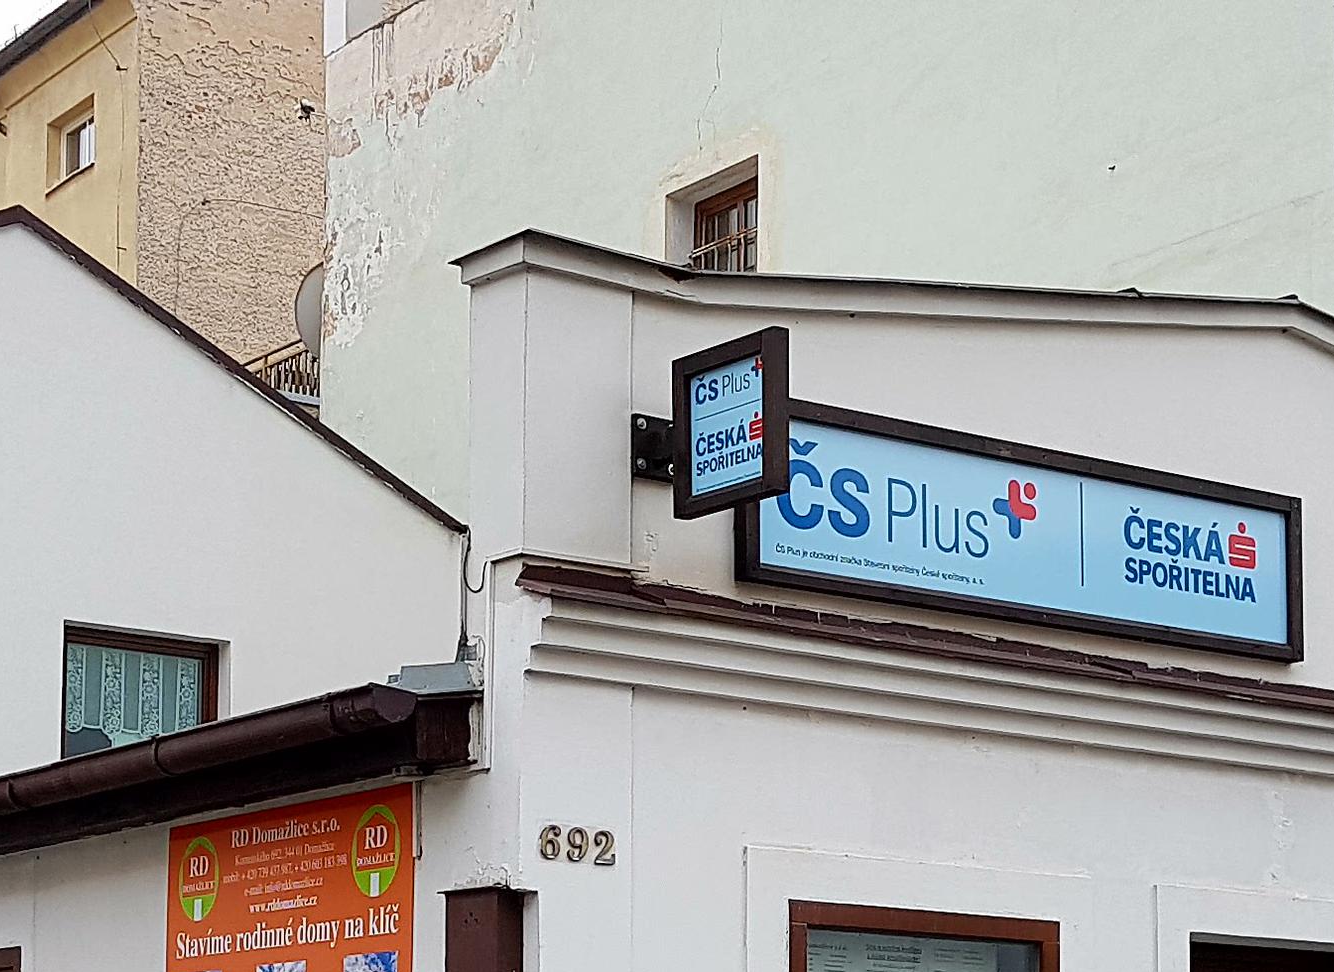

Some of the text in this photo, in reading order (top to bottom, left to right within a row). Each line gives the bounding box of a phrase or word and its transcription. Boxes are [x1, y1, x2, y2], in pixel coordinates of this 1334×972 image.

[695, 372, 750, 405] ČS Plus
[695, 418, 747, 457] ČESKÁ
[696, 443, 763, 477] SPOŘITELNA
[776, 438, 989, 558] ČS Plus
[775, 542, 786, 554] ČS
[1123, 505, 1226, 565] ČESKÁ
[1124, 556, 1257, 604] SPOŘITELNA
[231, 818, 341, 848] RD Domažlice s.r.o.
[364, 824, 388, 850] RD
[539, 824, 616, 866] 692
[189, 856, 209, 877] RD
[356, 852, 396, 867] DOMAŽLICE
[176, 903, 400, 960] Stavíme rodinné domy na klíč
